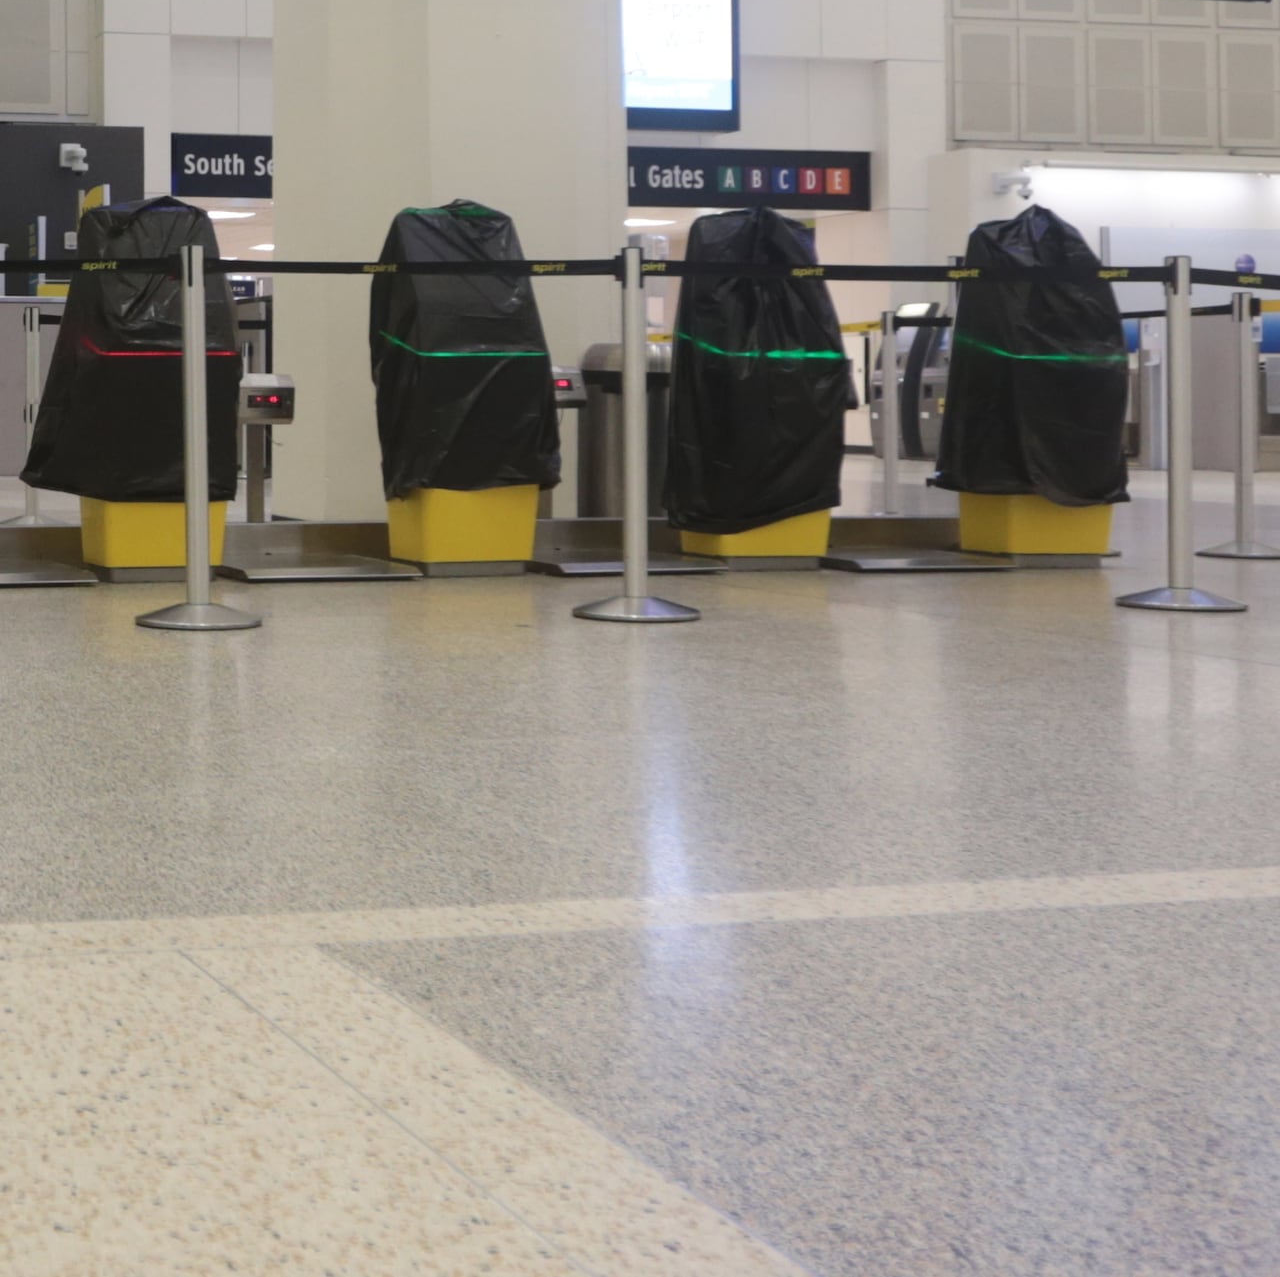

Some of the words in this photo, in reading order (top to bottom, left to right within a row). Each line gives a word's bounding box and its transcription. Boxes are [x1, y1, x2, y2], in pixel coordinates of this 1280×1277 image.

[184, 153, 245, 176] South
[648, 165, 704, 189] Gates
[724, 170, 736, 189] A
[752, 170, 762, 189] B
[779, 170, 790, 190] C
[806, 170, 816, 190] D
[834, 171, 843, 191] E
[81, 261, 117, 271] spirit
[531, 263, 567, 273] spirit
[641, 262, 666, 272] pirit
[792, 267, 824, 277] spirit
[948, 269, 980, 279] spirit
[1098, 269, 1129, 279] spirit
